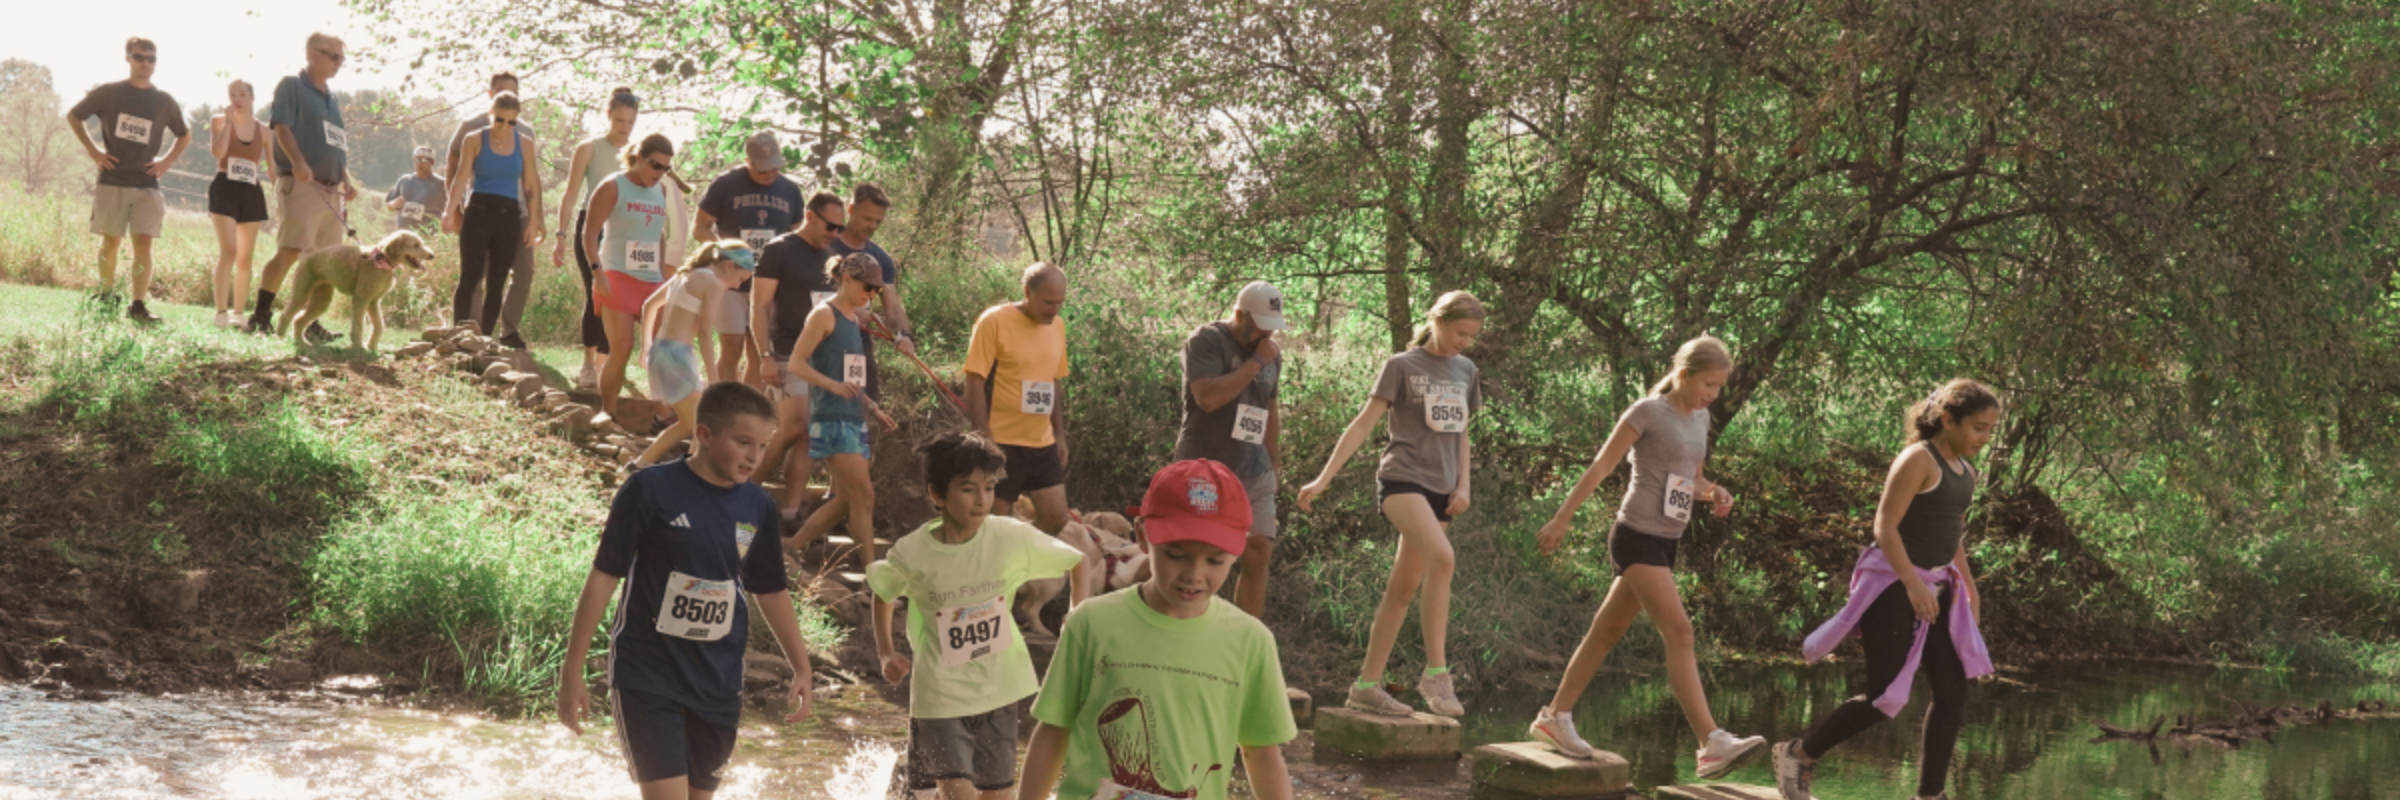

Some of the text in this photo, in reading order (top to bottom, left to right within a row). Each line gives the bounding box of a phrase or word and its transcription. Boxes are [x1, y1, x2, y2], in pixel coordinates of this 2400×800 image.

[671, 594, 729, 625] 8503
[928, 591, 956, 603] Run
[948, 615, 1001, 650] 8497
